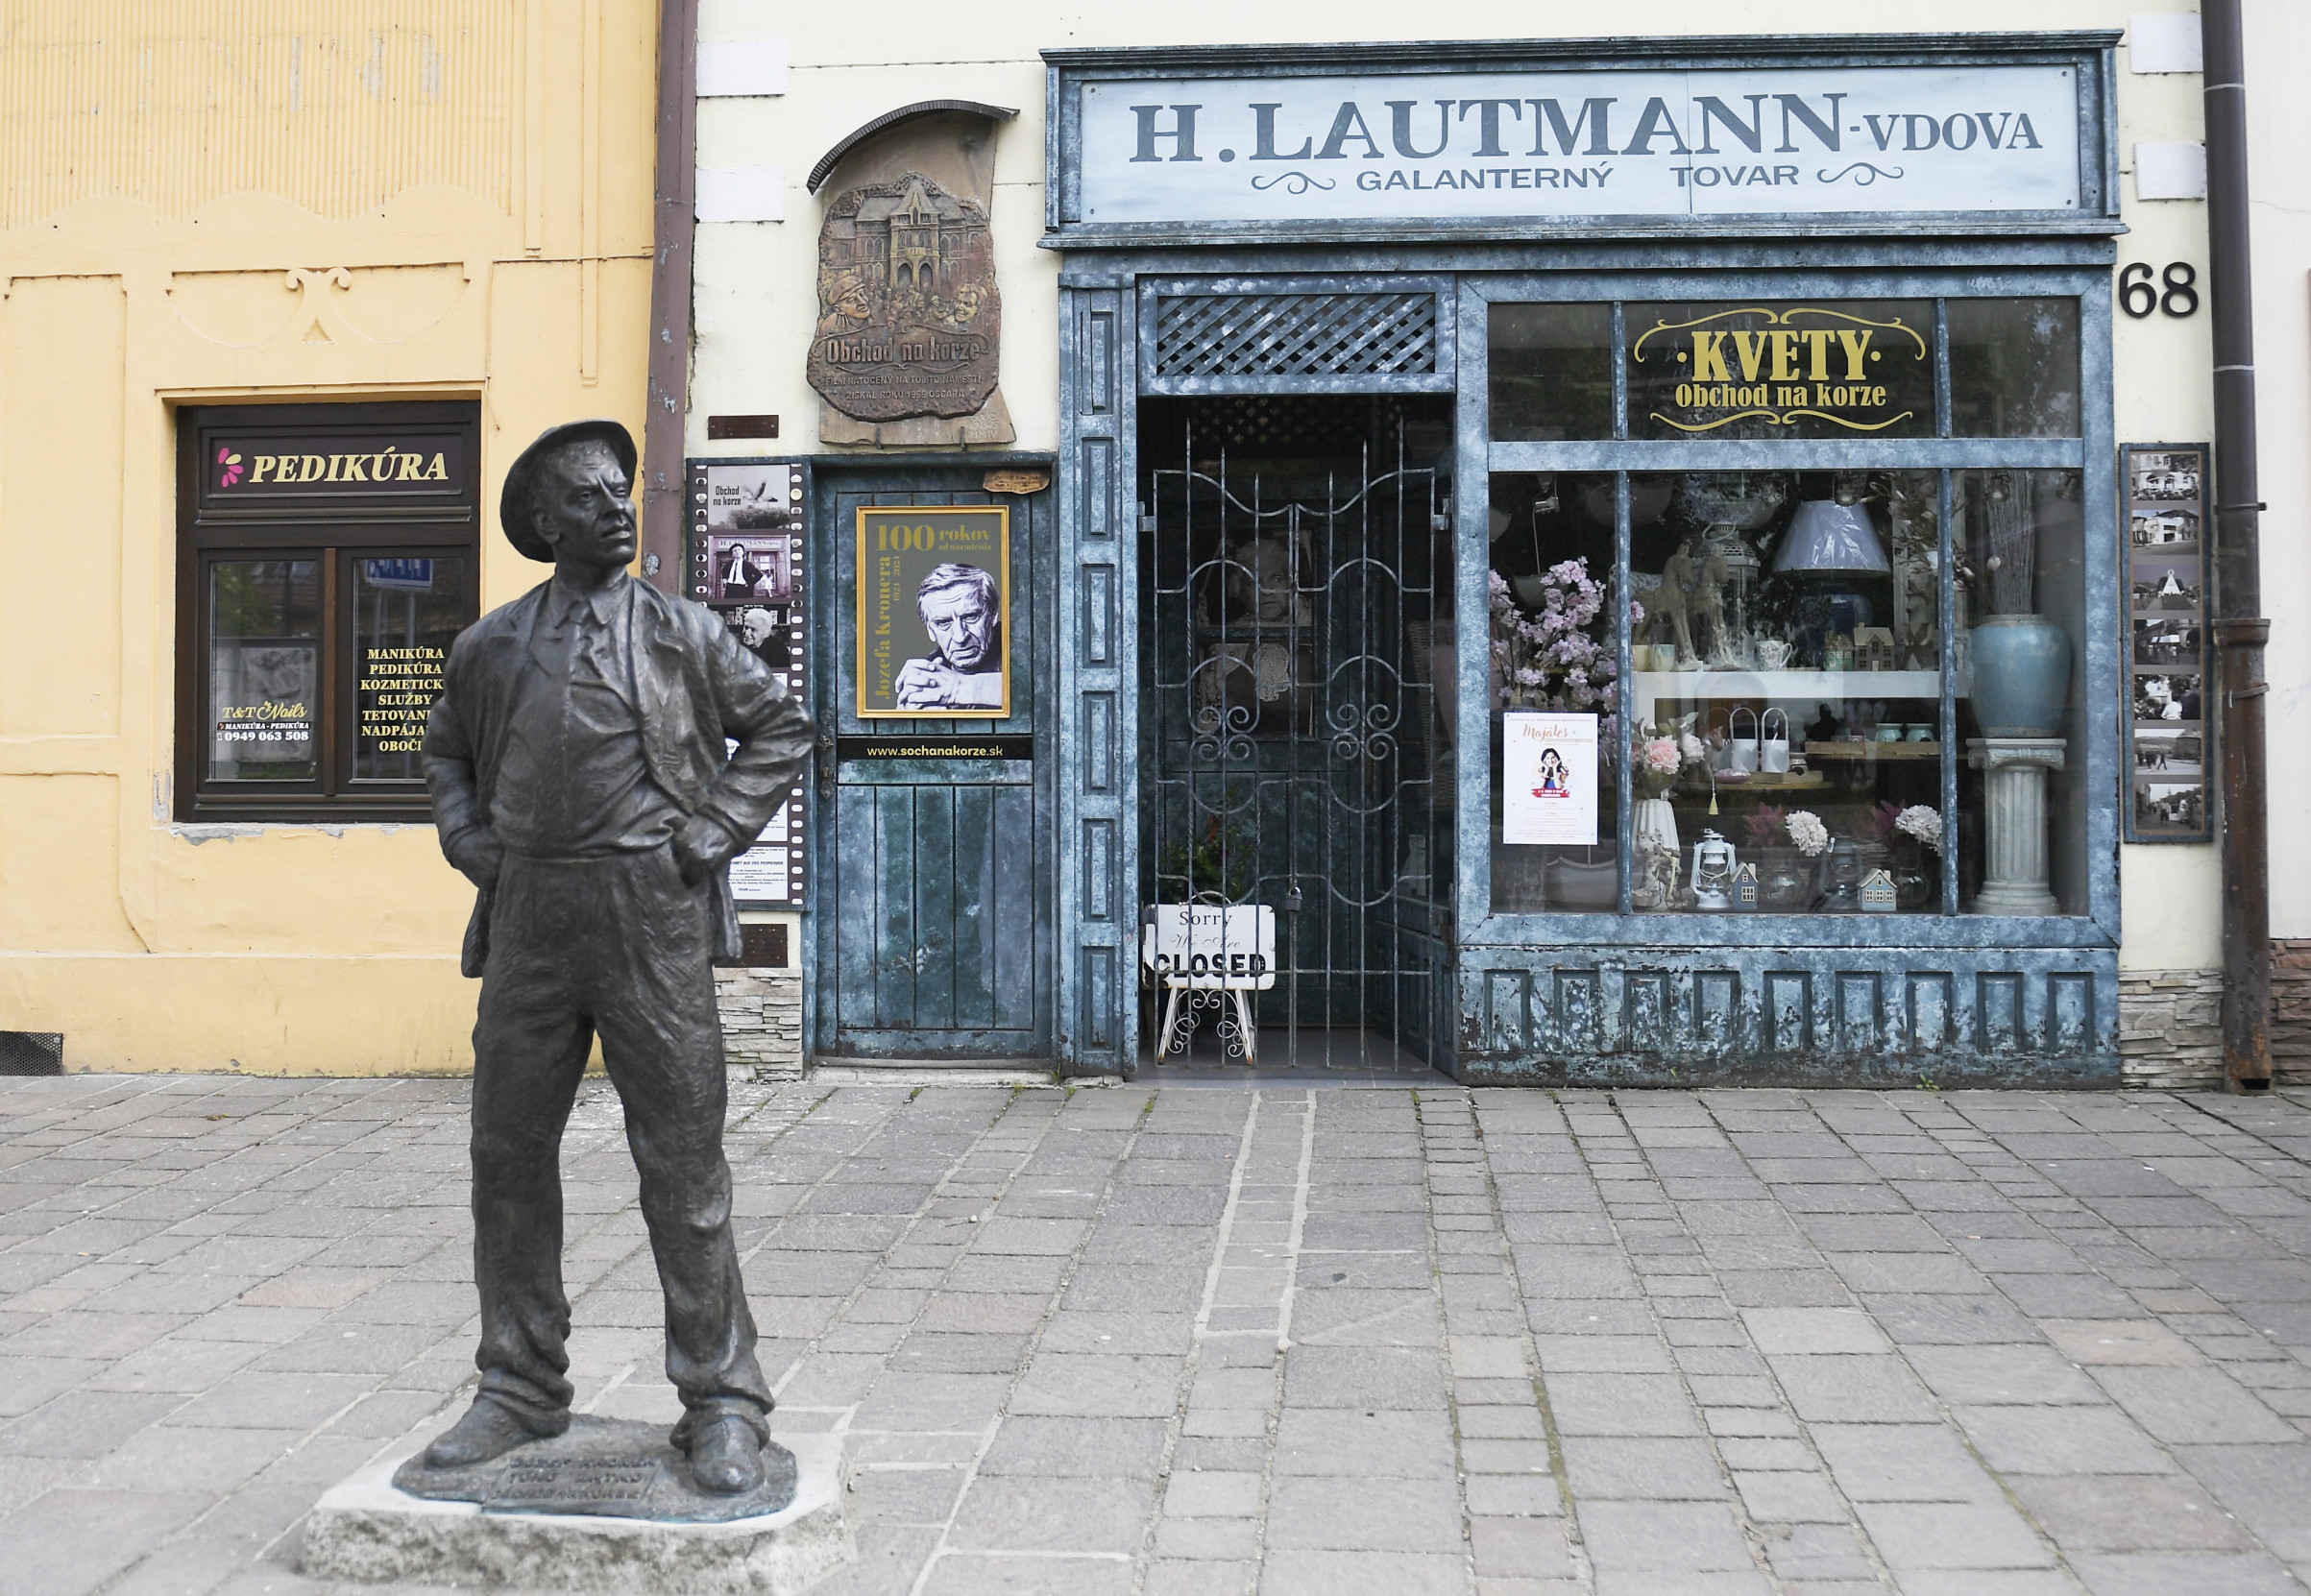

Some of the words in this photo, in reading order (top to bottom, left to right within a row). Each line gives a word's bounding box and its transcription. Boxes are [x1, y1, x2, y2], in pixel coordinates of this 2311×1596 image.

[1356, 161, 1614, 191] GALANTERNÝ
[1669, 164, 1799, 188] TOVAR
[2119, 261, 2199, 319] 68
[827, 337, 893, 363] Obchod
[902, 342, 924, 362] na
[930, 336, 980, 362] korze
[1691, 329, 1873, 381] KVETY
[1675, 383, 1768, 407] Obchod
[1777, 387, 1808, 407] na
[1816, 383, 1886, 407] korze
[249, 446, 449, 483] PEDIKÚRA
[715, 485, 740, 496] Obchod
[722, 496, 742, 506] korze
[876, 524, 936, 551] 100
[939, 524, 992, 541] rokov
[367, 646, 445, 660] MANIKÚRA
[369, 662, 443, 675] PEDIKÚRA
[874, 641, 891, 699] Jozefa
[359, 679, 444, 690] KOZMETICK
[377, 692, 433, 706] SLUŽBY
[223, 706, 256, 718] T&T
[256, 701, 307, 720] Nails
[270, 721, 309, 730] PEDIKÚRA
[224, 731, 256, 741] 0949
[258, 731, 282, 741] 063
[284, 731, 309, 741] 508
[866, 745, 1003, 757] www.sochanakorze.sk
[1180, 911, 1232, 928] Sorry
[1153, 954, 1266, 979] CLOSED
